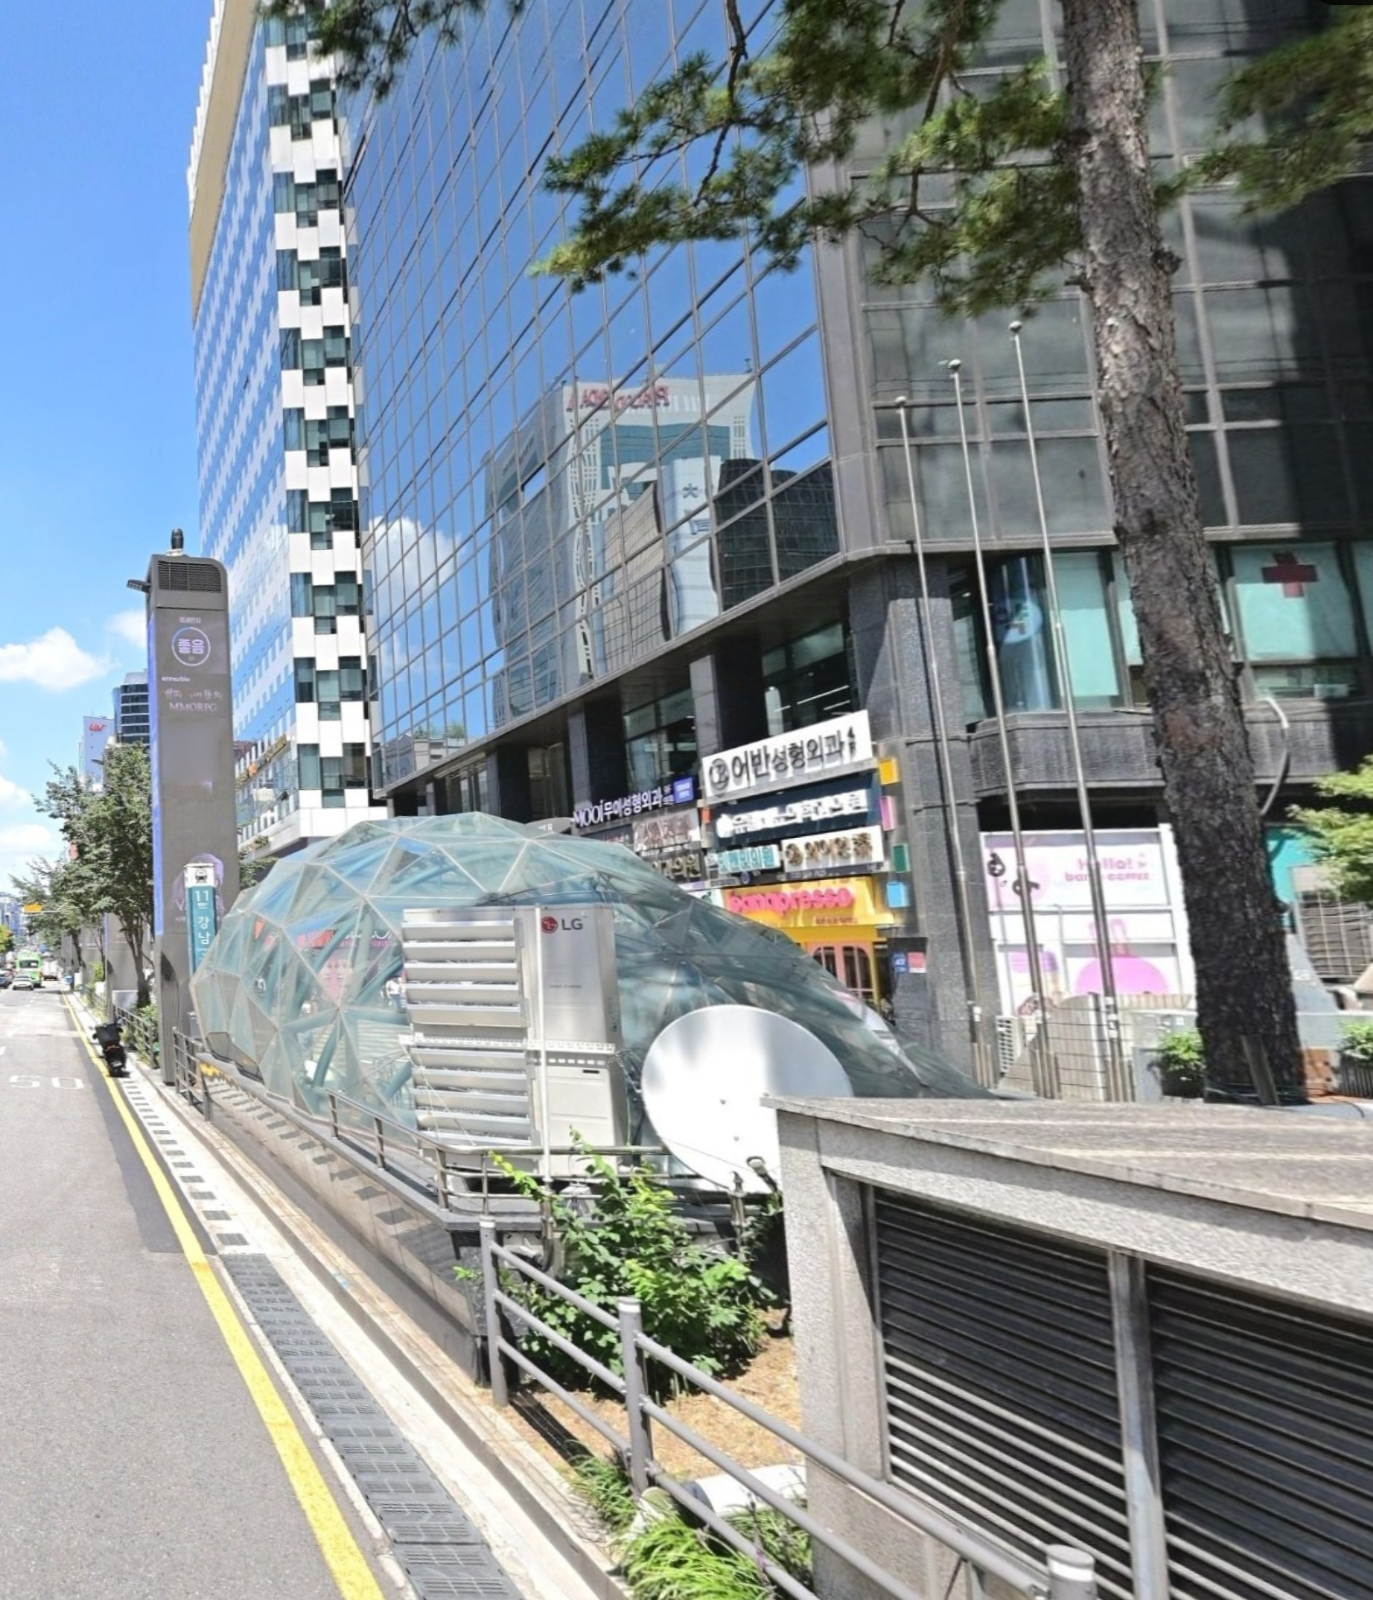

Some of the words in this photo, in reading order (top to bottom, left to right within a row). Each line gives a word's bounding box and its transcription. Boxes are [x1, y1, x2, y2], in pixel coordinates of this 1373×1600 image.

[178, 638, 205, 655] 좋음
[169, 702, 218, 712] MMORPG
[731, 729, 844, 789] 어반성형외과
[195, 890, 210, 902] 11
[197, 915, 211, 945] 강남
[561, 918, 584, 931] LG
[8, 1074, 85, 1090] 50
